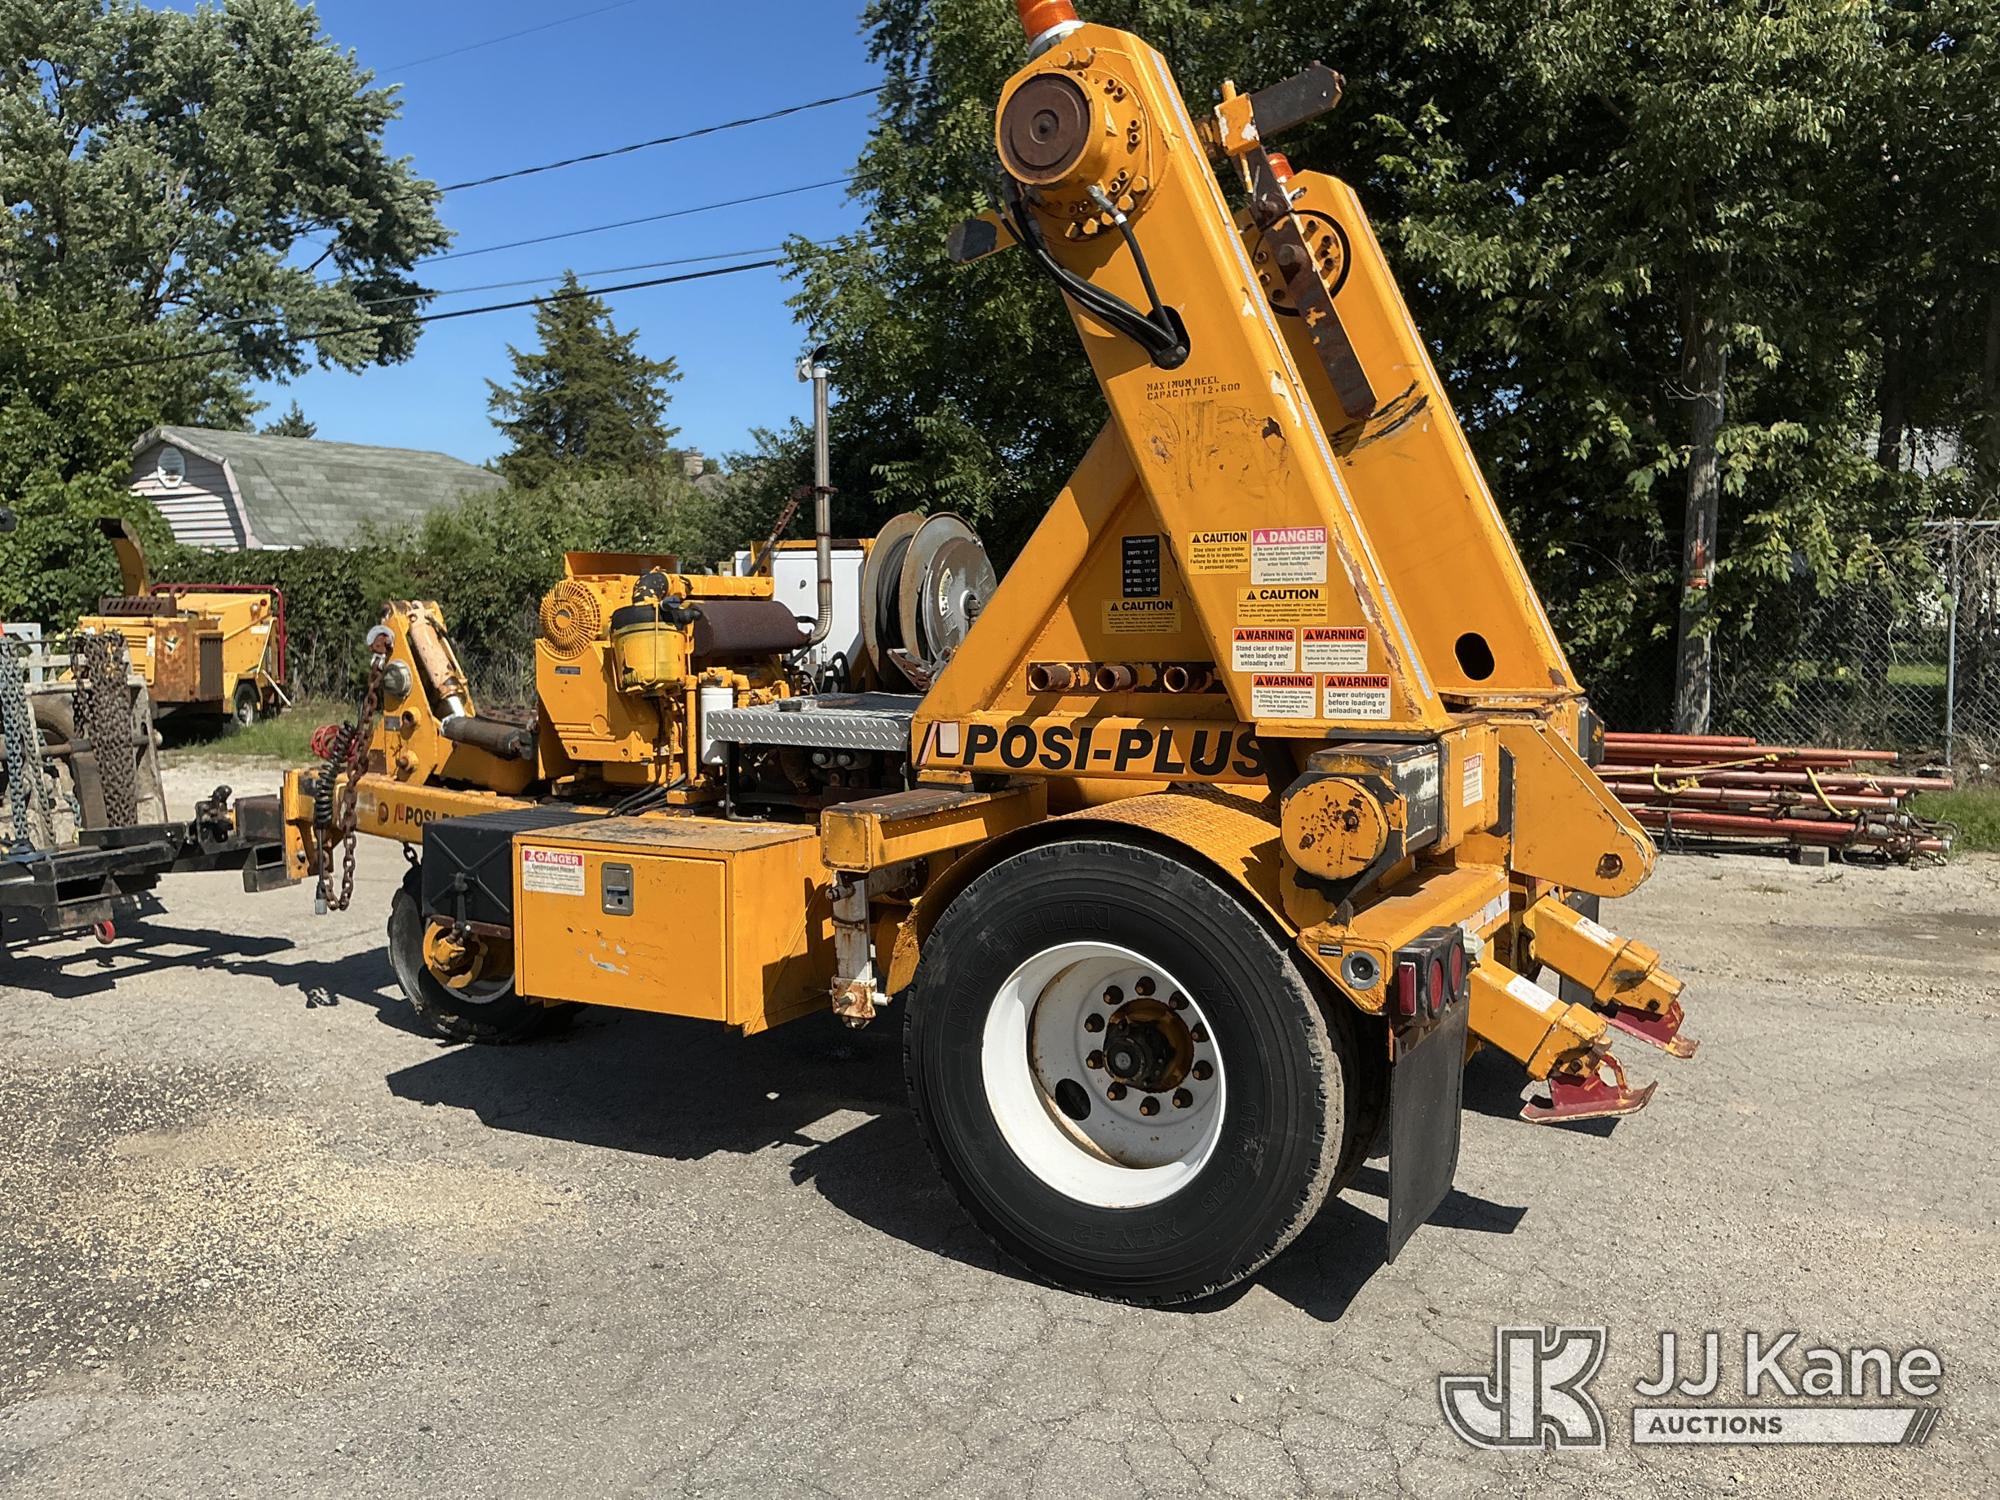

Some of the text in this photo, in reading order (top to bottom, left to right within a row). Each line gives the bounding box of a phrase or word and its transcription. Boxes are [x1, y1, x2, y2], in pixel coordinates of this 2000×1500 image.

[1194, 375, 1220, 386] REEL
[1147, 387, 1198, 401] CAPACITY
[1203, 532, 1247, 543] CAUTION
[1269, 529, 1324, 543] DANGER
[1260, 589, 1319, 600] CAUTION
[1122, 600, 1173, 611] CAUTION
[1245, 630, 1293, 640] WARNING
[1315, 630, 1364, 640] WARNING
[1264, 676, 1313, 686] WARNING
[1337, 677, 1388, 687] WARNING
[963, 724, 1266, 777] POSI-PLUS
[535, 852, 579, 864] DANGER
[948, 903, 1109, 1031] MICHELIN
